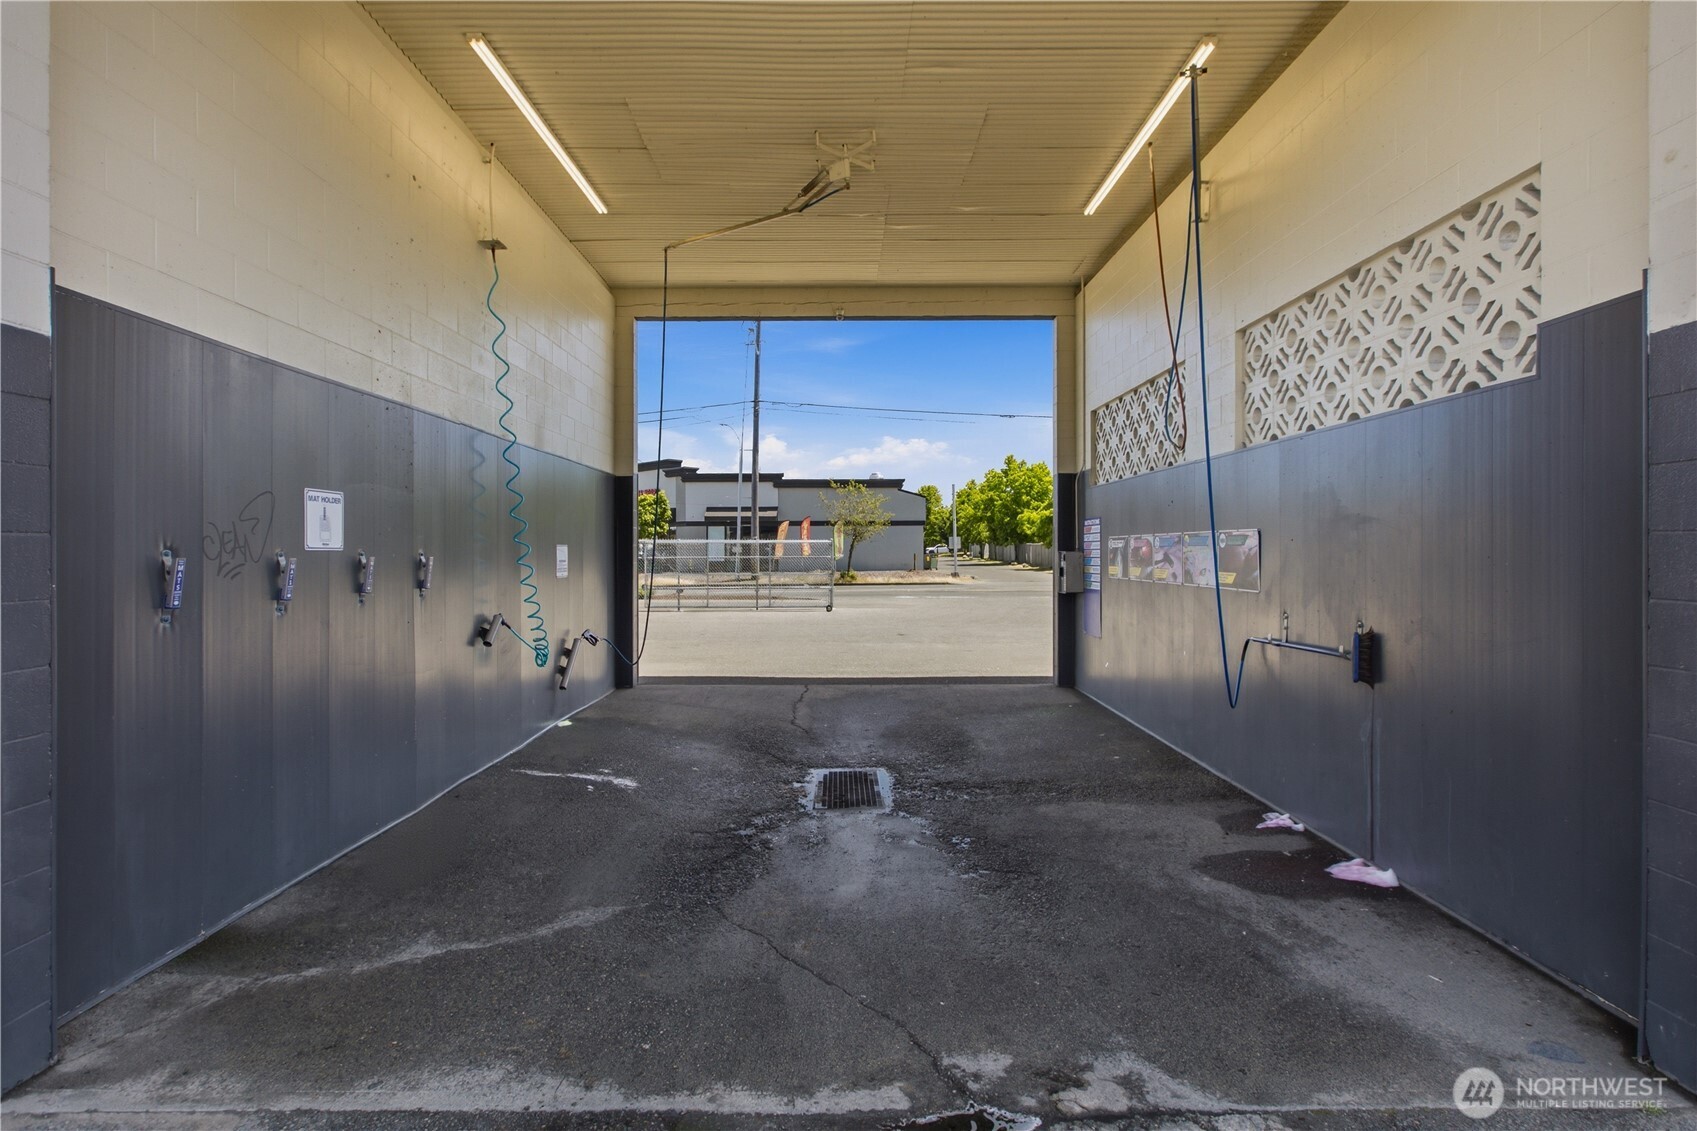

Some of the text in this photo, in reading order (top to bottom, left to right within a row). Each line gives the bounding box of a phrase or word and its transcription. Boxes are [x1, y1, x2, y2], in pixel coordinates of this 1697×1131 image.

[308, 495, 342, 505] MAT HOLDER
[175, 565, 185, 591] MATS
